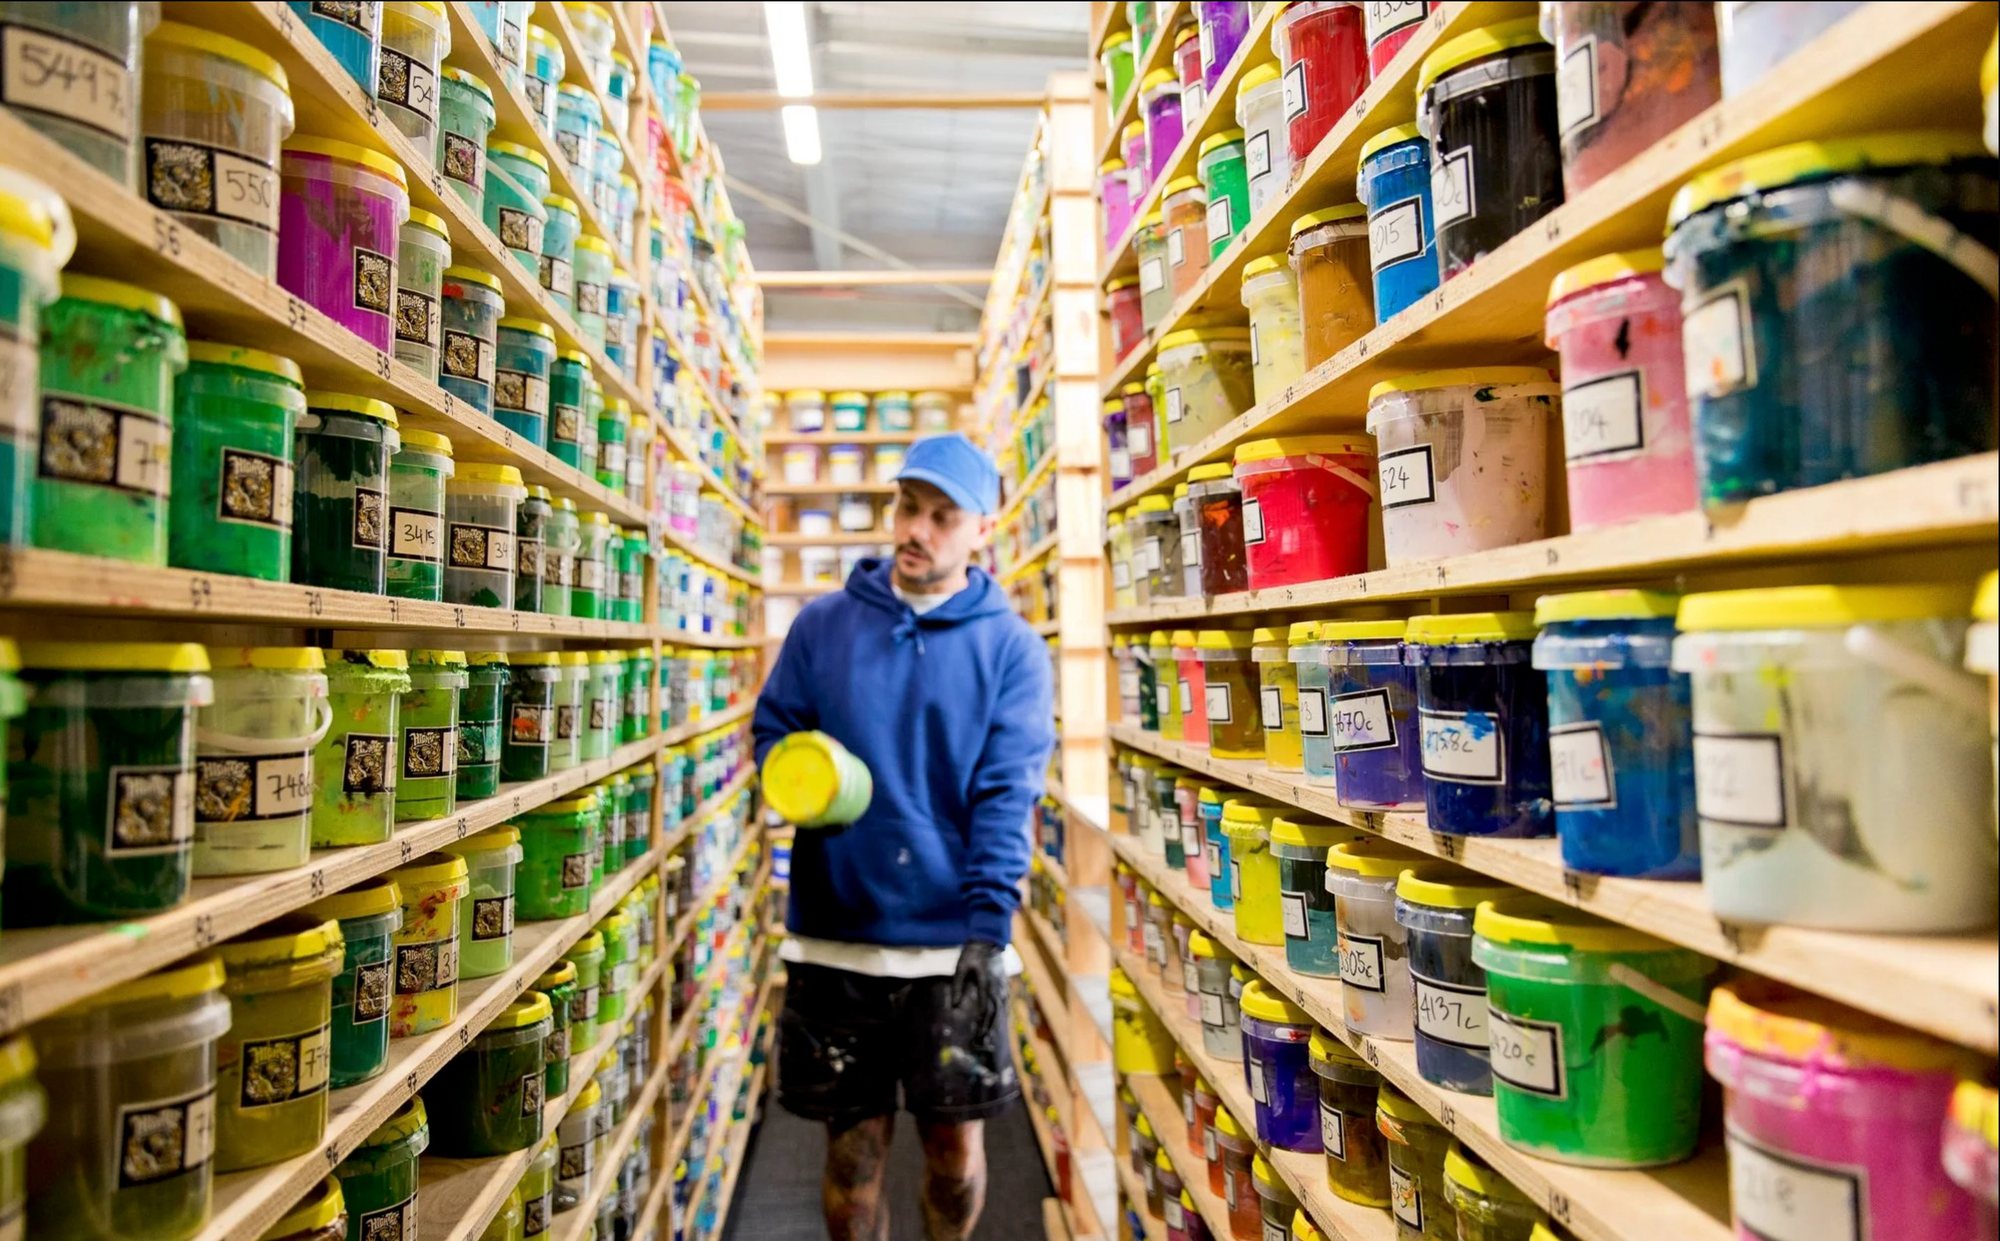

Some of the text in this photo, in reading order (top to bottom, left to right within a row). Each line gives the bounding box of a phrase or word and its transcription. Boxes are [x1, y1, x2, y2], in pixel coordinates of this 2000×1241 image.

[1374, 214, 1405, 254] 015
[376, 351, 391, 381] 58
[403, 524, 435, 545] 3415
[305, 591, 322, 616] 70
[1419, 993, 1482, 1030] 4137c
[1366, 1038, 1380, 1067] 106
